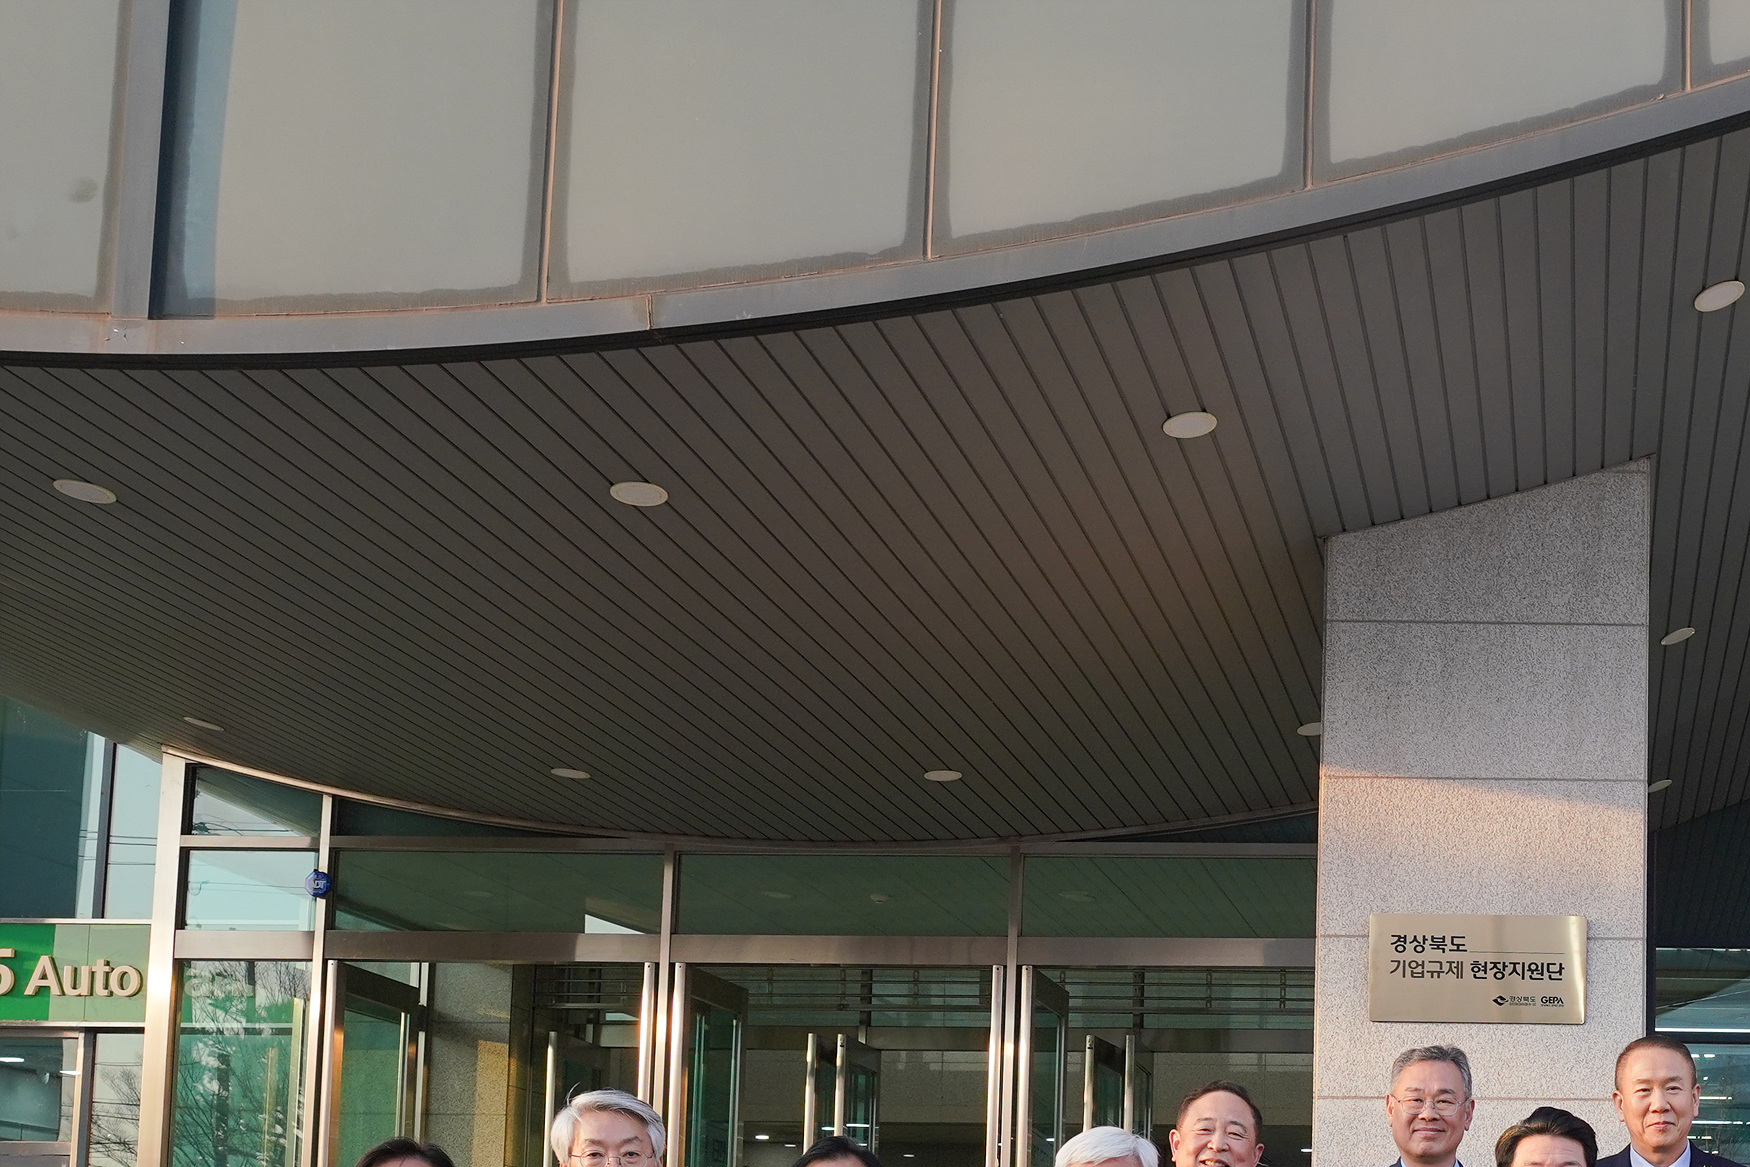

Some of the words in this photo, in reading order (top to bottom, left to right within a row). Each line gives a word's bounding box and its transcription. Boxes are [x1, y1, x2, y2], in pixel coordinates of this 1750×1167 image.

[1390, 934, 1468, 954] 경상북도
[24, 955, 142, 997] Auto
[1389, 959, 1464, 980] 기업규제
[1469, 960, 1566, 981] 현장지원단
[1540, 996, 1564, 1004] GEPA
